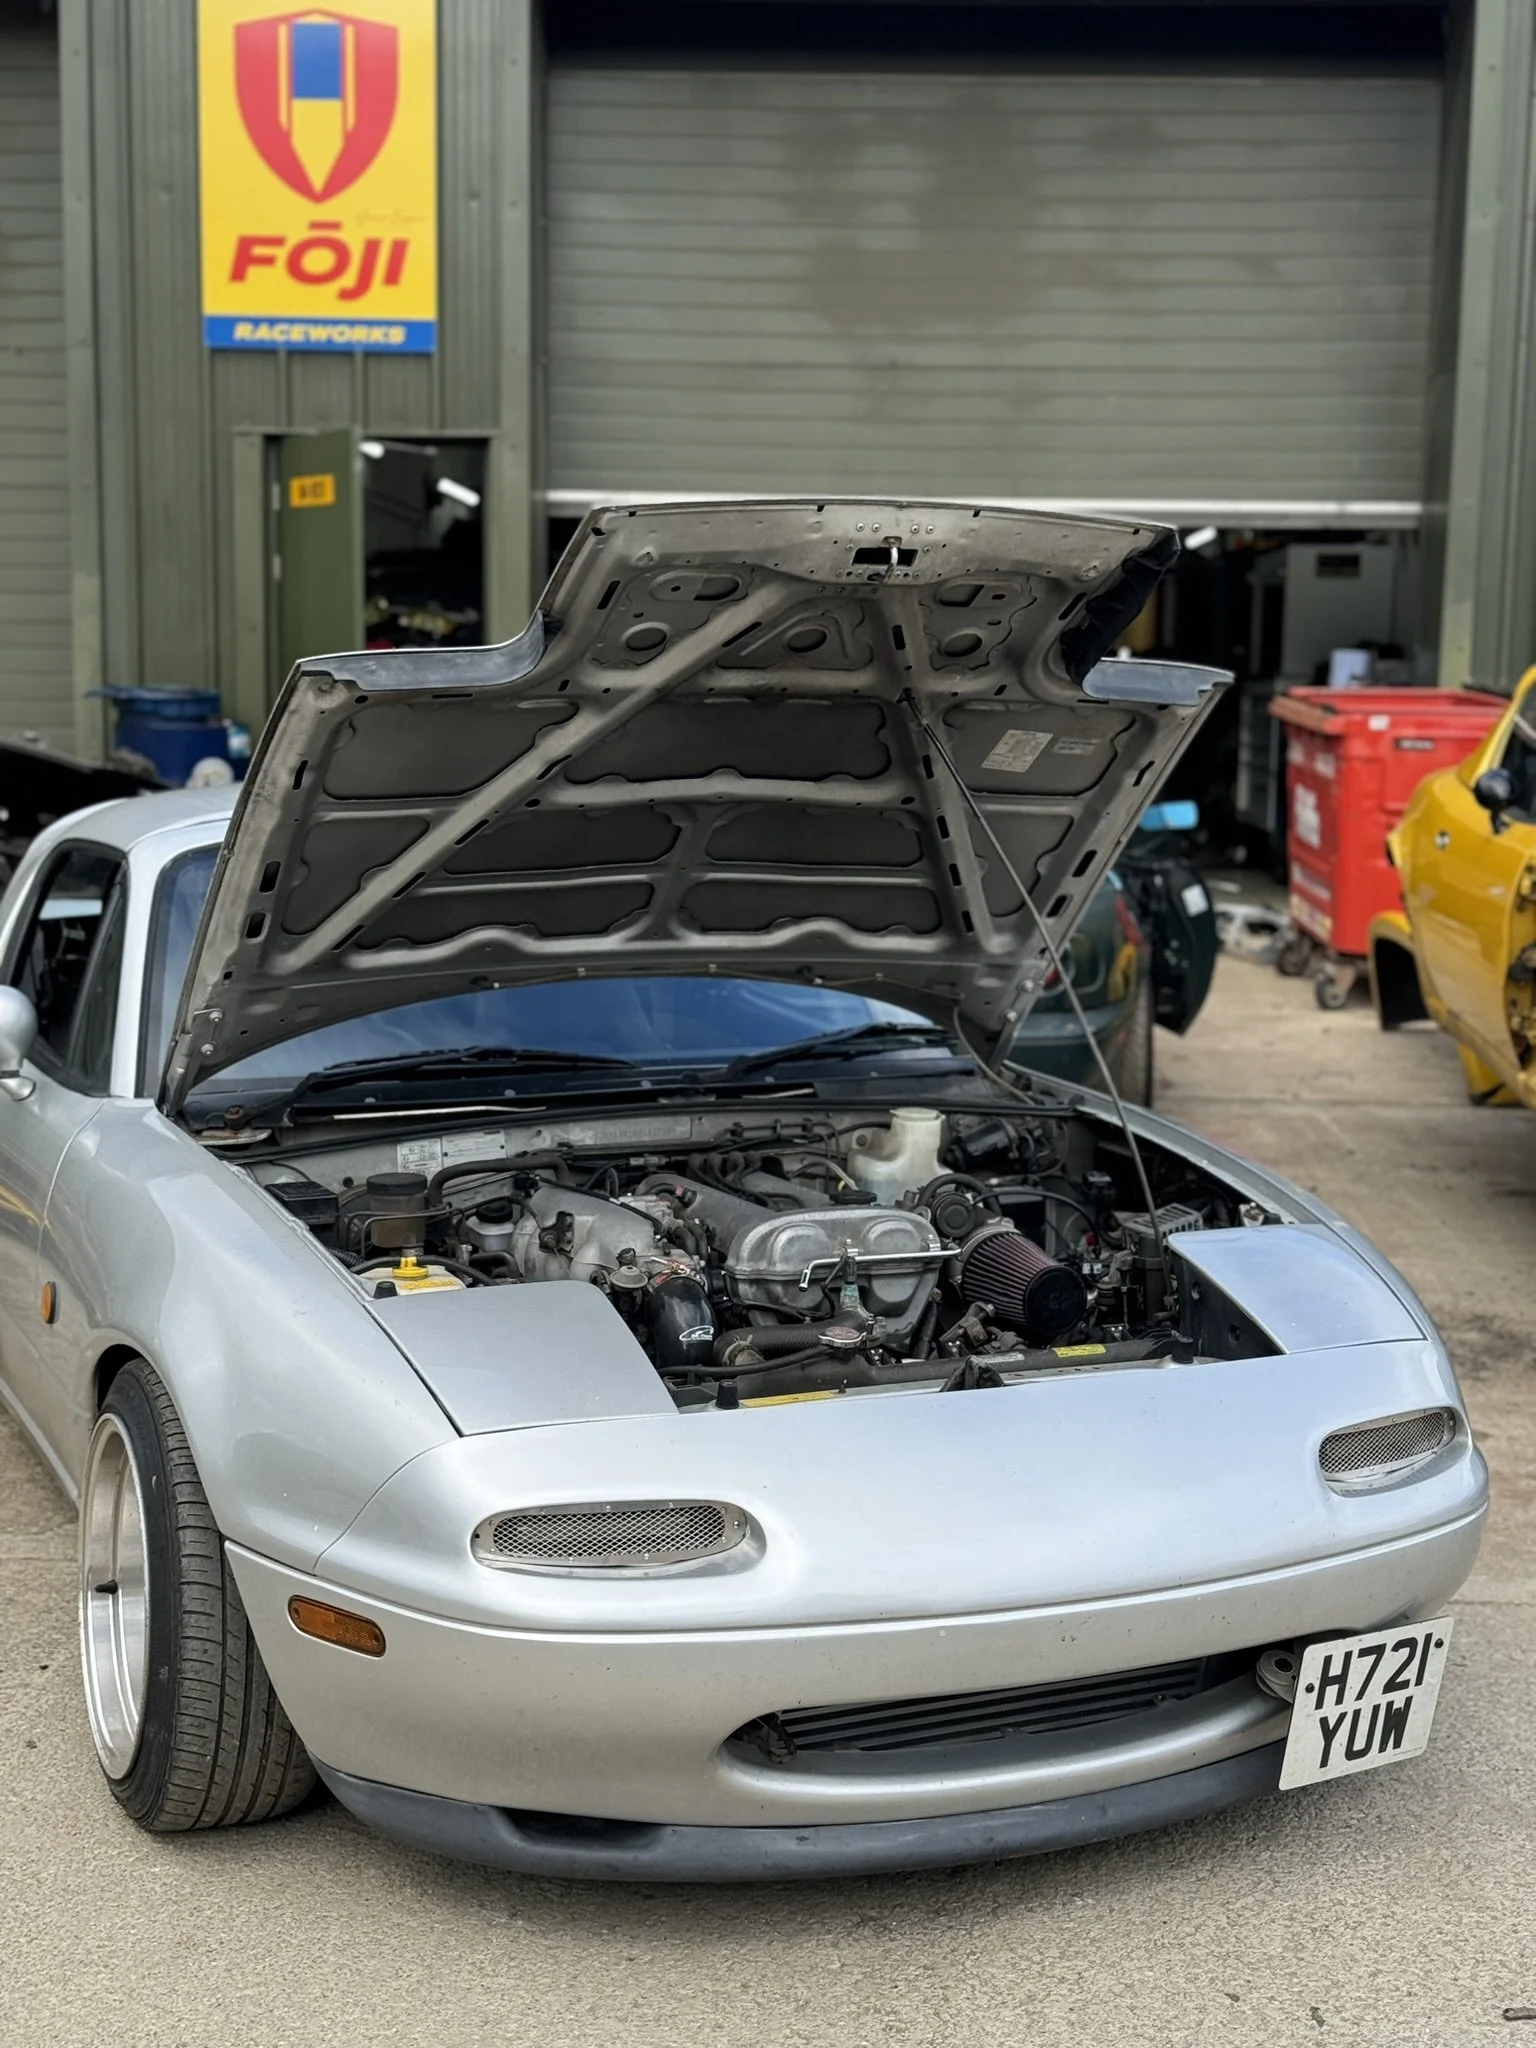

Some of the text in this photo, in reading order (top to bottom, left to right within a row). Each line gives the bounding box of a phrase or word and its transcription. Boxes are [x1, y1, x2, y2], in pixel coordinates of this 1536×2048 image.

[229, 220, 409, 301] FŌJI
[233, 322, 406, 344] RACEWORKS
[1314, 1632, 1433, 1710] H721
[1318, 1695, 1414, 1769] YUW
